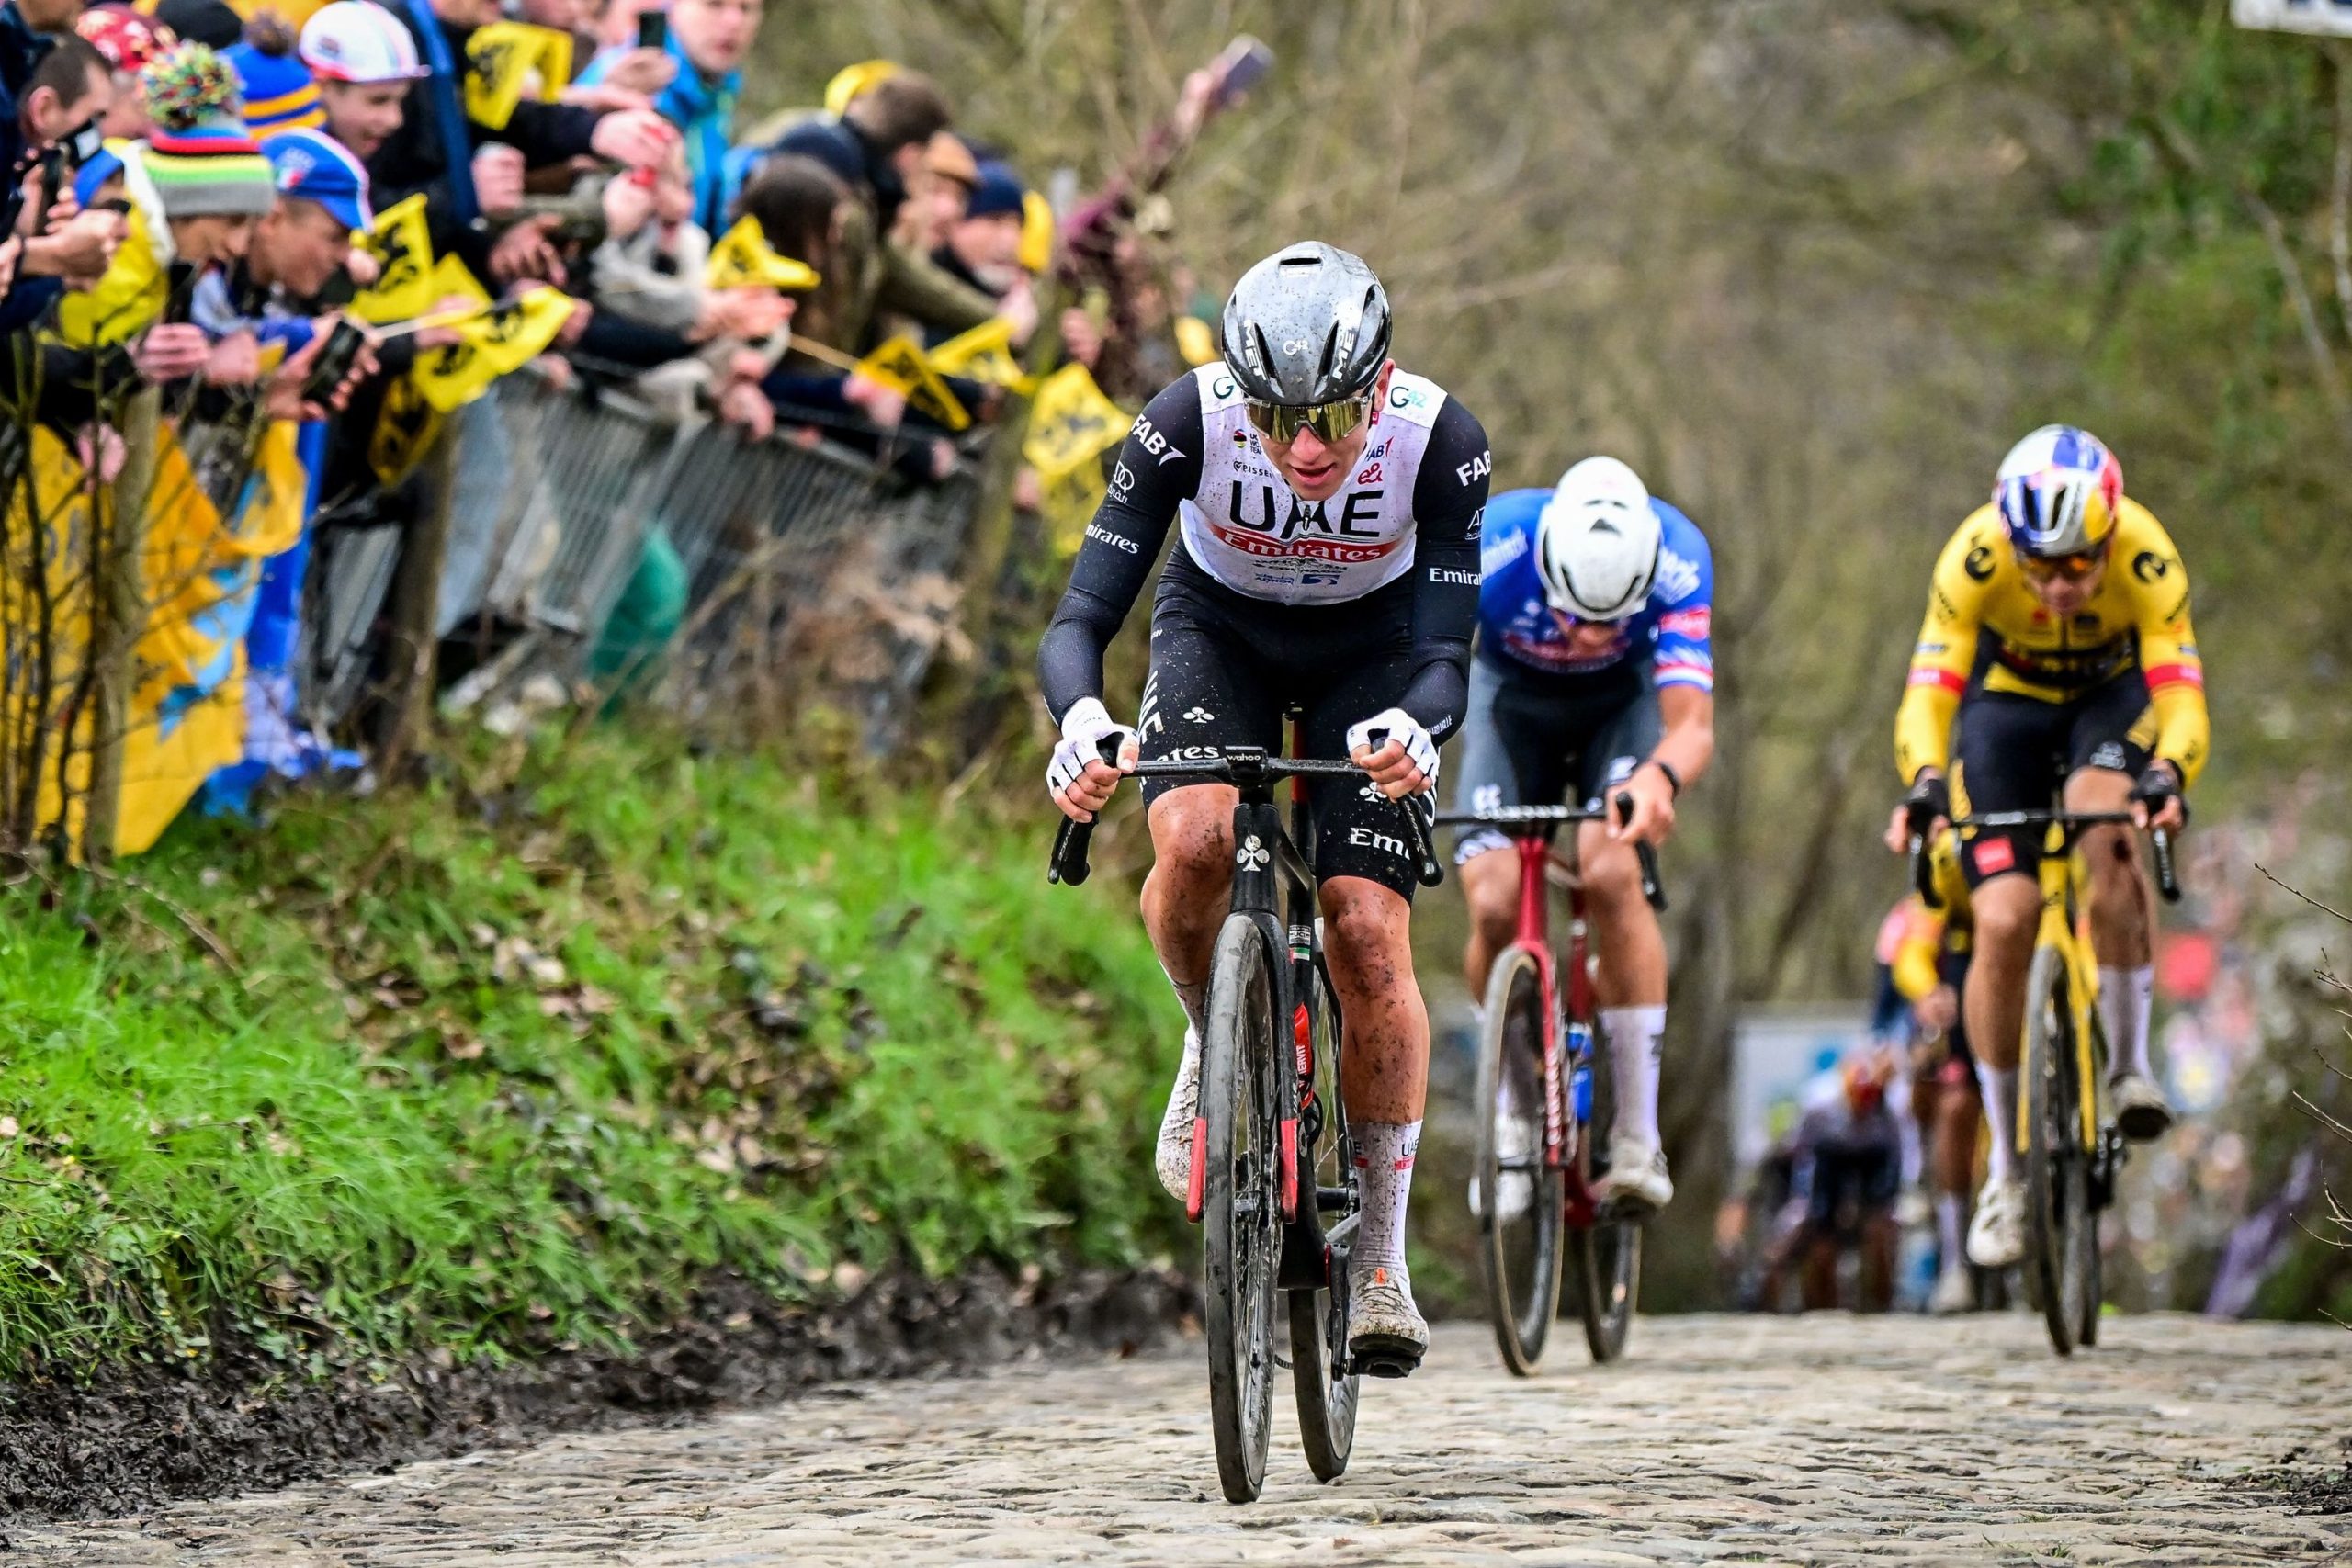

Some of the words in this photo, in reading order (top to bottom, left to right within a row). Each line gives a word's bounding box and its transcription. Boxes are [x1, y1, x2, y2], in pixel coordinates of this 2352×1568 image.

[1390, 386, 1427, 408] G42
[1229, 479, 1385, 540] UAE
[1085, 524, 1140, 554] mirates
[1223, 530, 1381, 563] Emirates
[1227, 752, 1261, 761] wahoo
